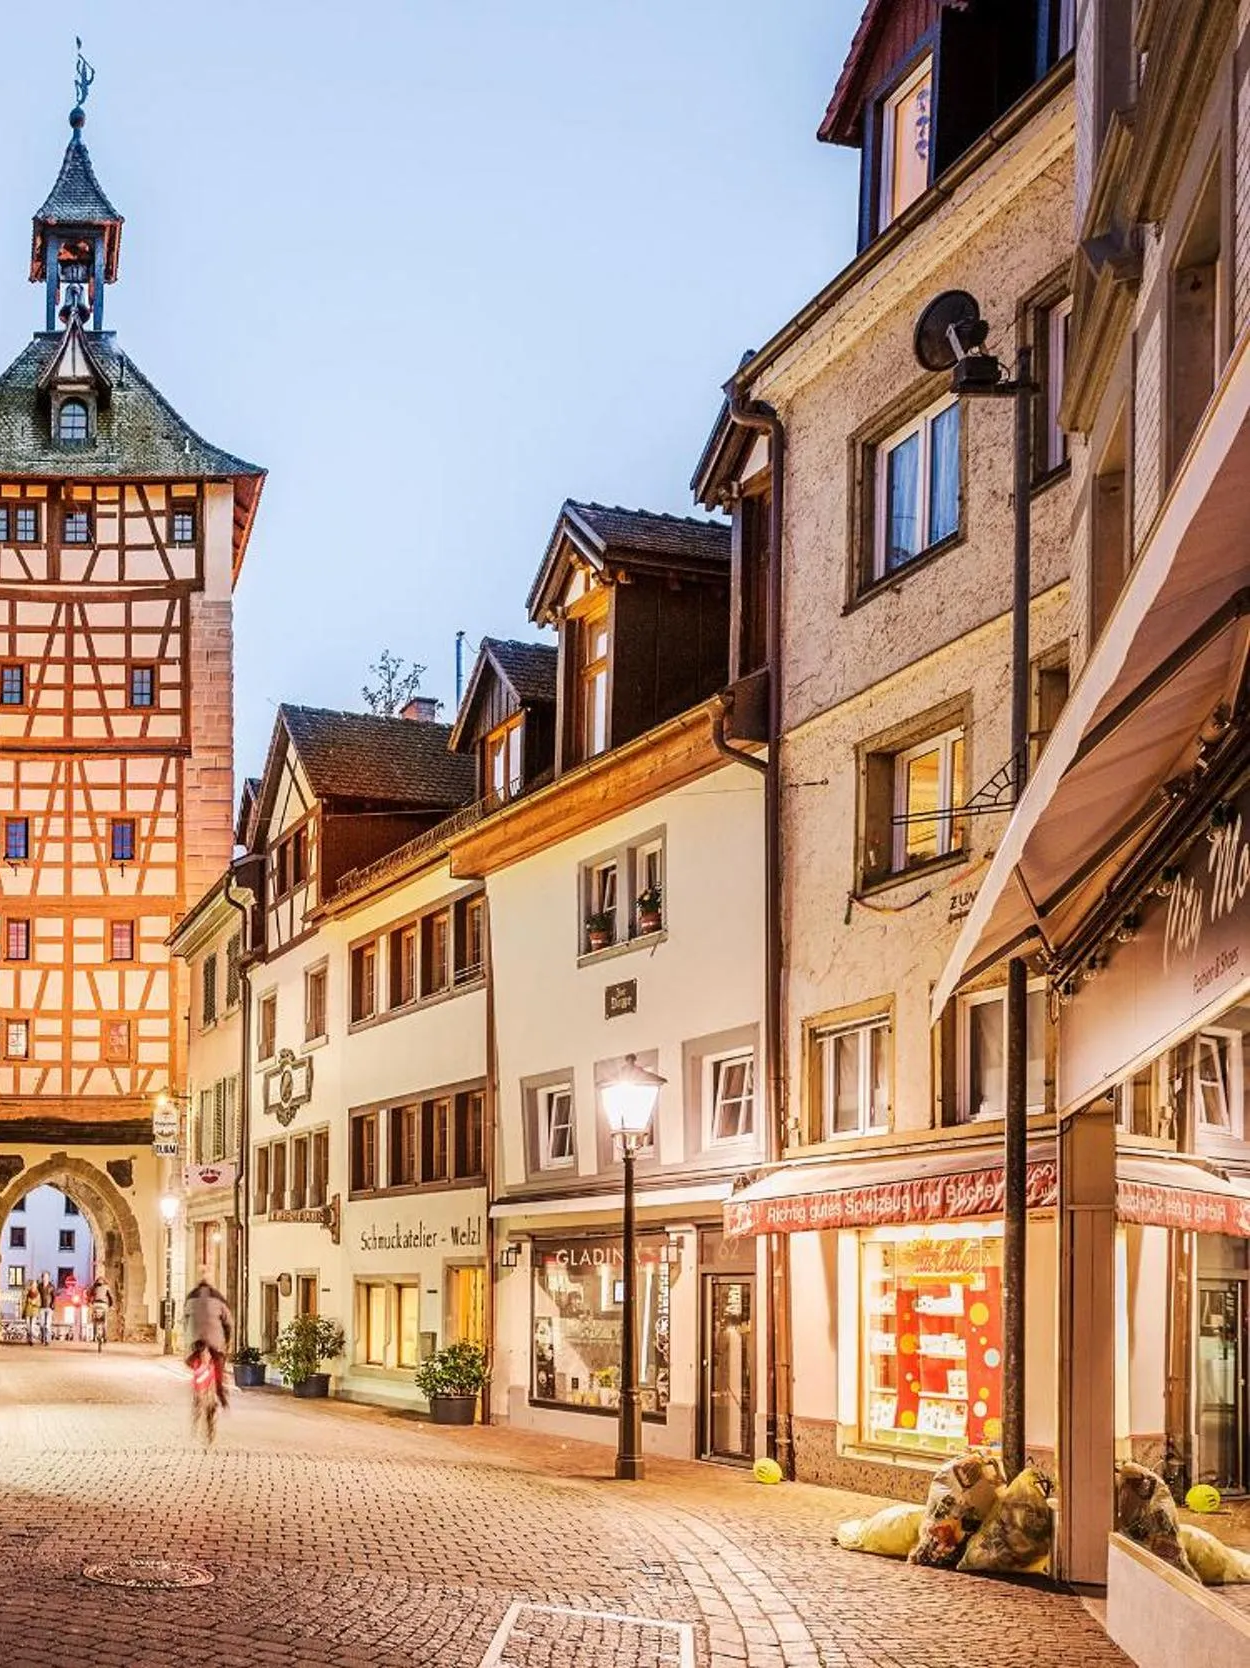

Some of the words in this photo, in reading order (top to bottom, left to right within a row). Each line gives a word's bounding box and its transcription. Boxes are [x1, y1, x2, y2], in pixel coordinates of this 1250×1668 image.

[767, 1203, 807, 1225] Richtig
[810, 1197, 842, 1220] gutes
[845, 1192, 911, 1218] Spielzeug
[913, 1188, 941, 1209] und
[945, 1180, 1003, 1206] Büche
[360, 1222, 438, 1252] Schmuckatelier
[451, 1216, 481, 1247] Welzl
[718, 1238, 740, 1260] 62
